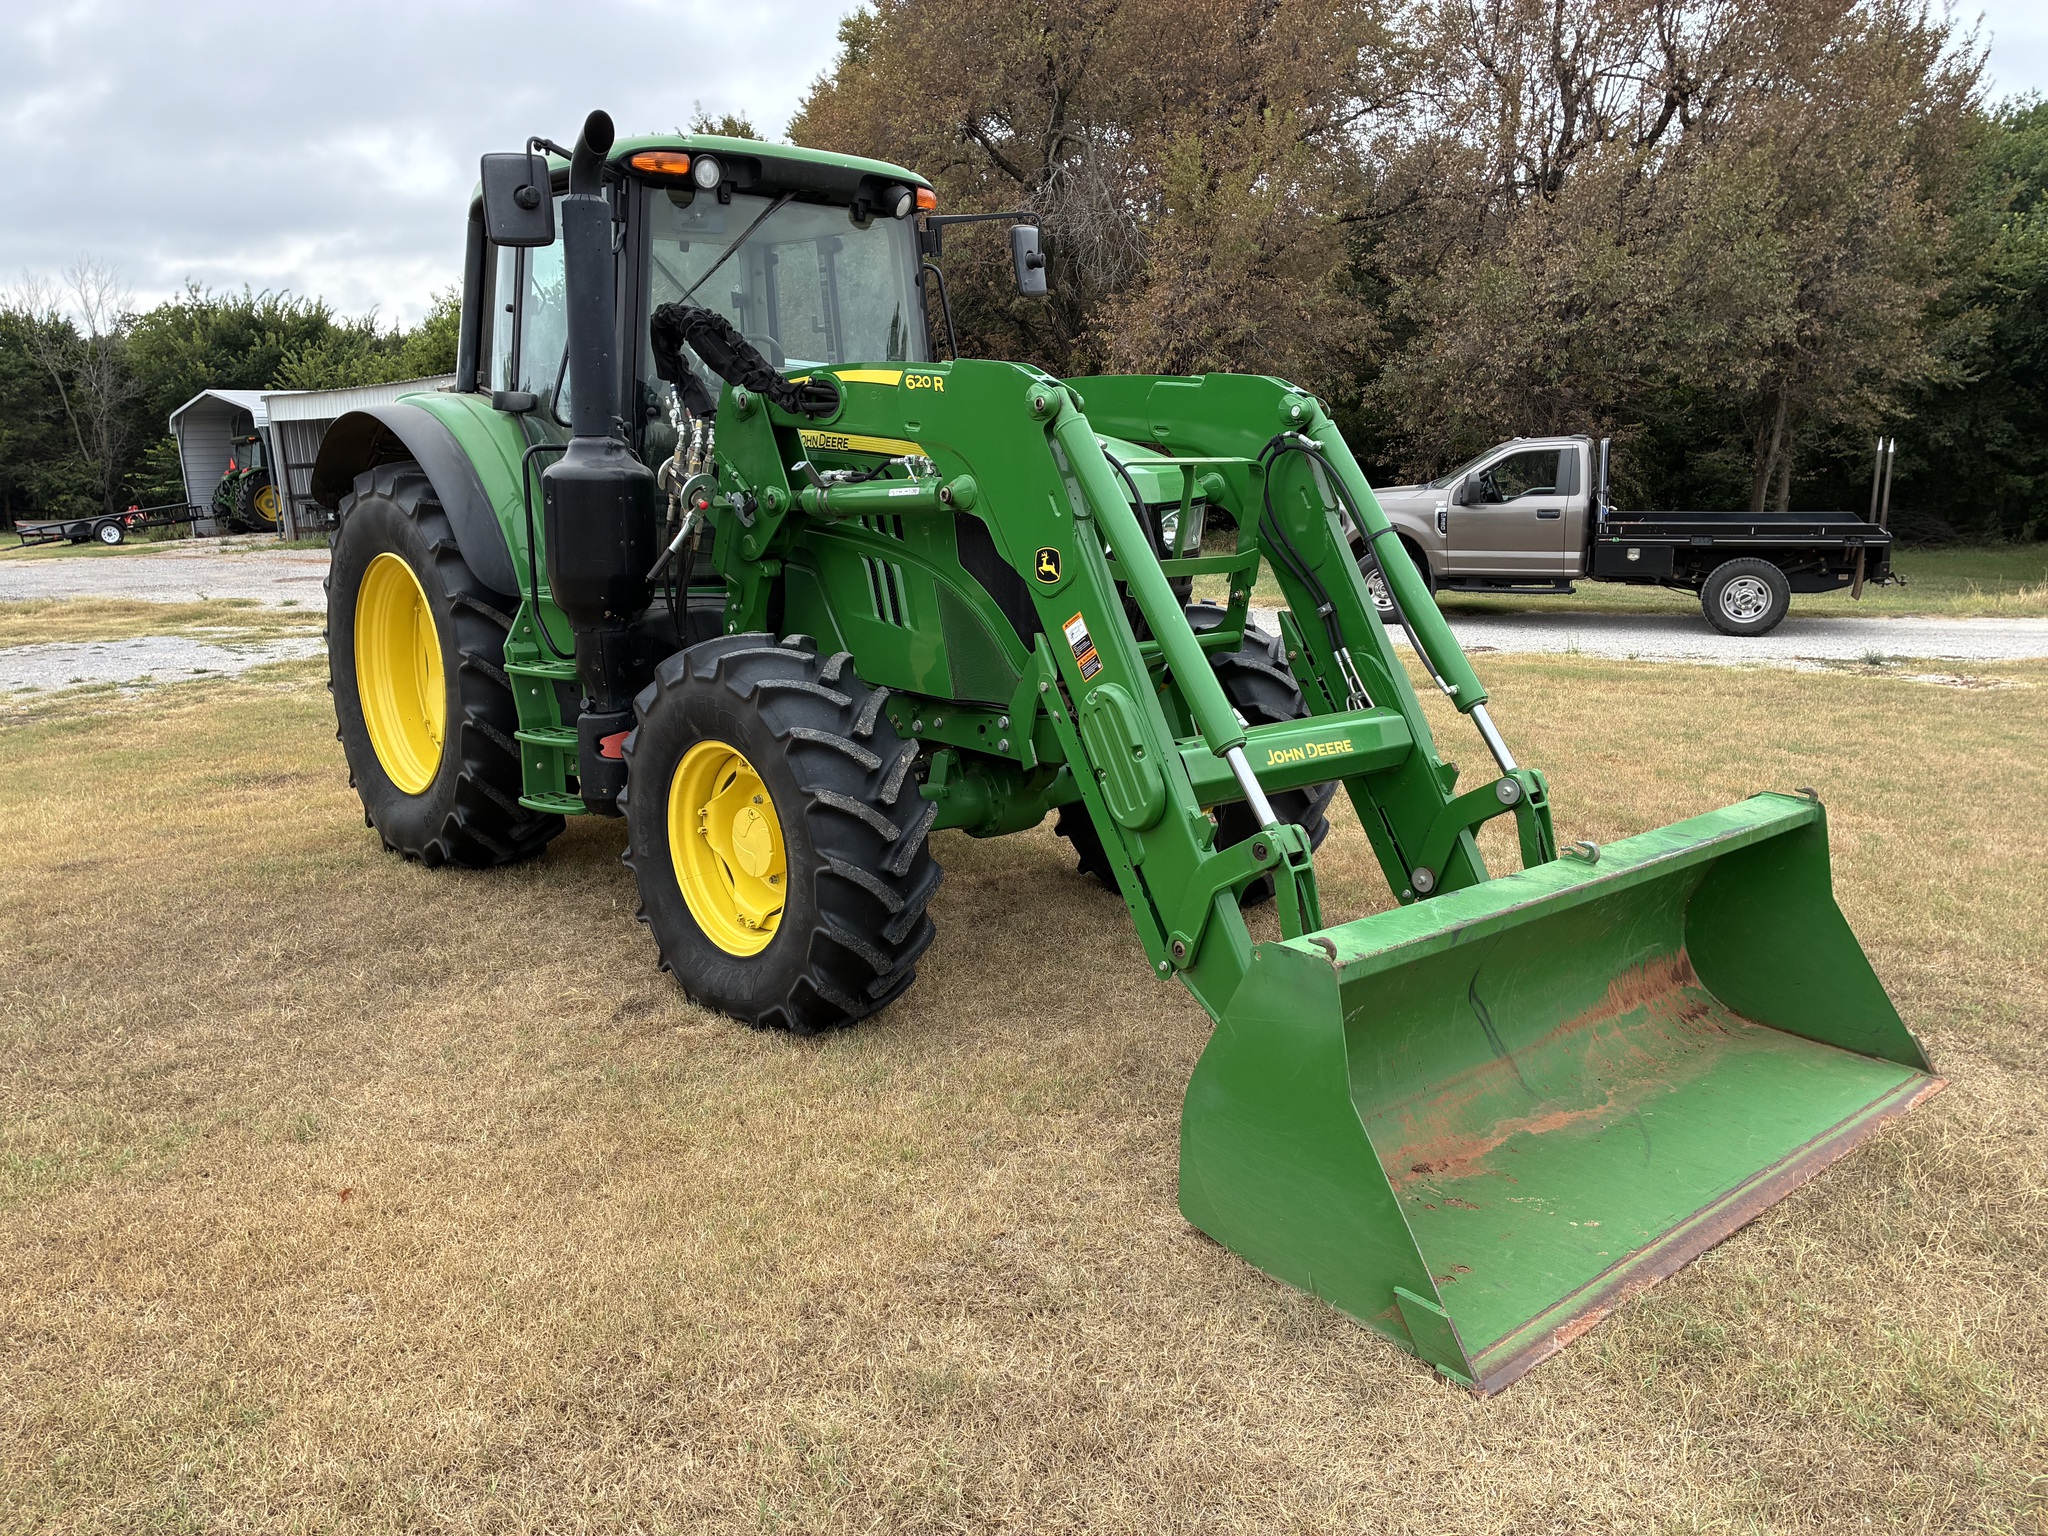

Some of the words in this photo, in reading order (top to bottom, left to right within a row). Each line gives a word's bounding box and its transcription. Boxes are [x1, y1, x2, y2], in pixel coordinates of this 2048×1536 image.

[905, 374, 932, 390] 620
[933, 376, 945, 393] R
[800, 434, 819, 448] OHN
[819, 433, 850, 450] DEERE
[1266, 747, 1306, 766] JOHN
[1305, 739, 1354, 758] DEERE
